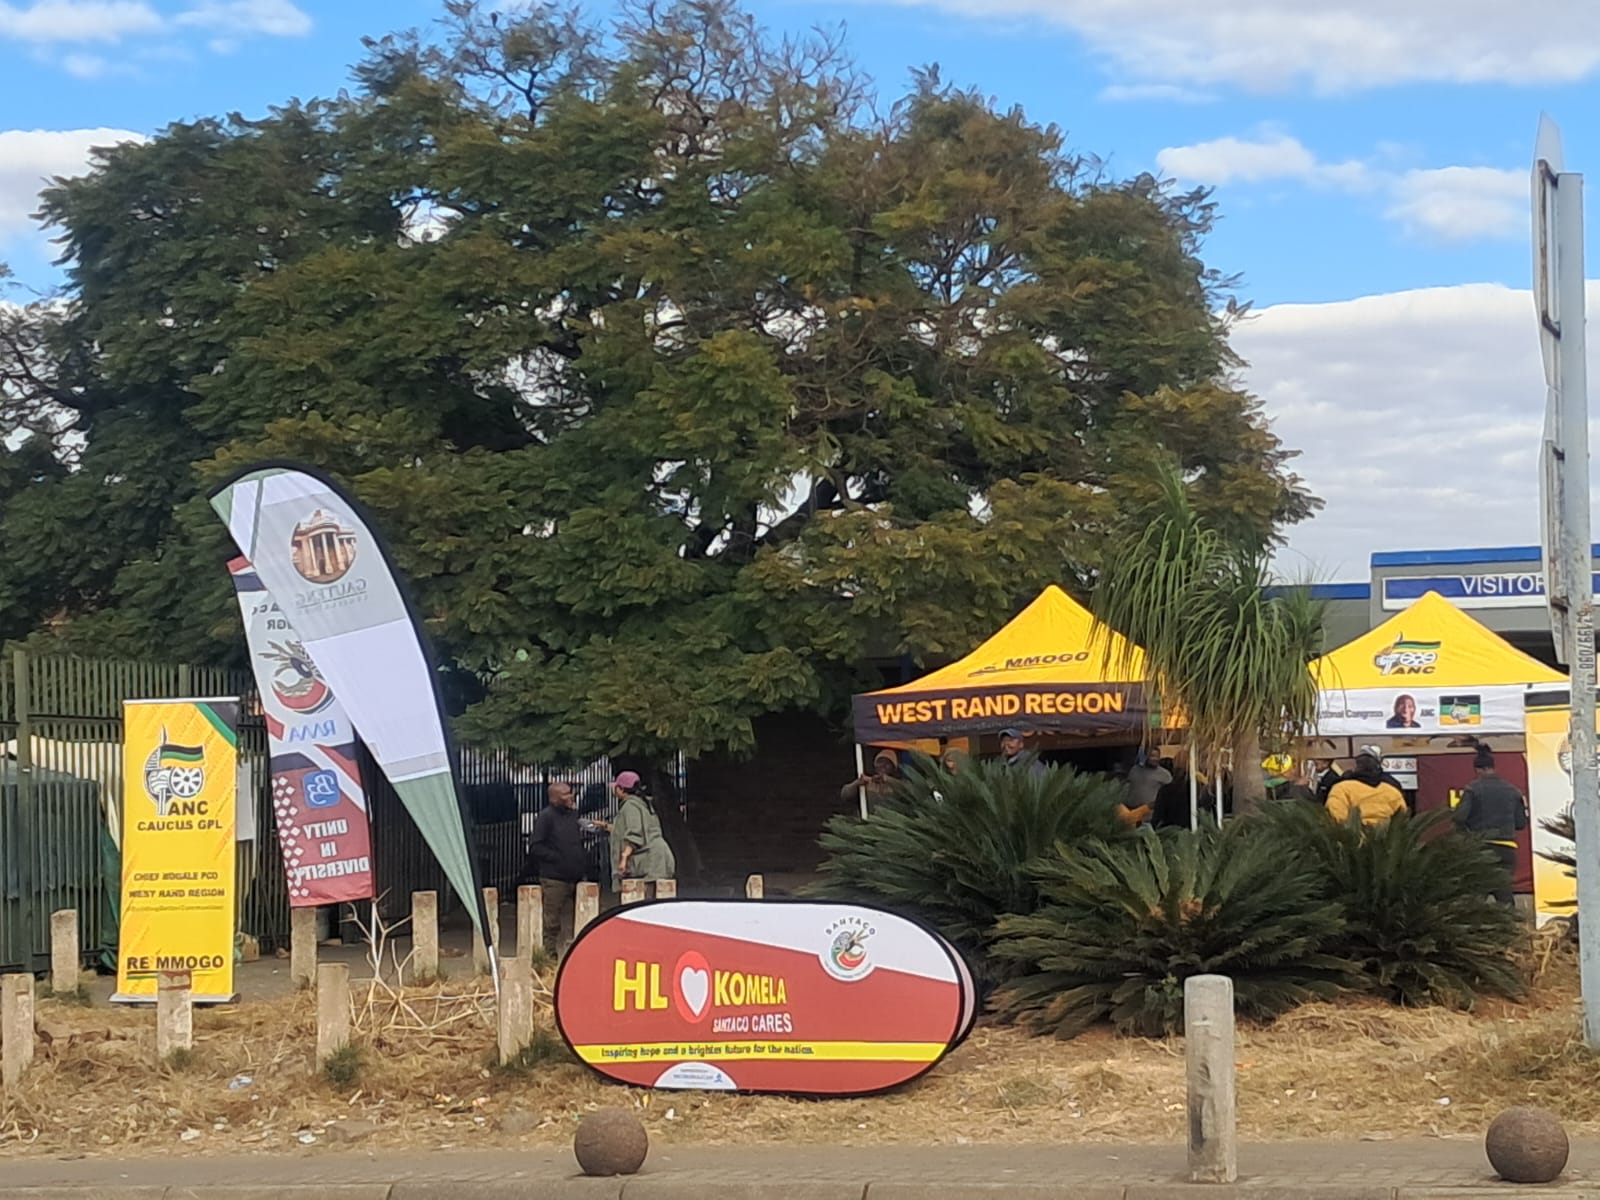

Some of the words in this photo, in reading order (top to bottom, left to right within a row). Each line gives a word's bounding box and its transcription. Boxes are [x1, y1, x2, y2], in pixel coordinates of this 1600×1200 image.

[1005, 651, 1089, 669] MMOGO
[1392, 666, 1436, 675] ANC
[877, 700, 946, 724] WEST
[952, 695, 1020, 718] RAND
[1025, 692, 1122, 714] REGION
[168, 800, 209, 816] ANC
[137, 820, 194, 831] CAUCUS
[198, 819, 222, 830] GPL
[128, 890, 156, 898] WEST
[159, 889, 185, 897] RAND
[188, 888, 225, 896] REGION
[126, 956, 149, 969] RE
[156, 955, 224, 969] MMOGO
[714, 970, 787, 1007] KOMELA
[752, 1012, 793, 1033] CARES
[601, 1047, 638, 1058] Inspiring
[640, 1046, 661, 1057] hope
[663, 1045, 678, 1055] and
[681, 1047, 686, 1055] a
[725, 1044, 751, 1054] future
[753, 1043, 765, 1053] for
[768, 1044, 782, 1053] the
